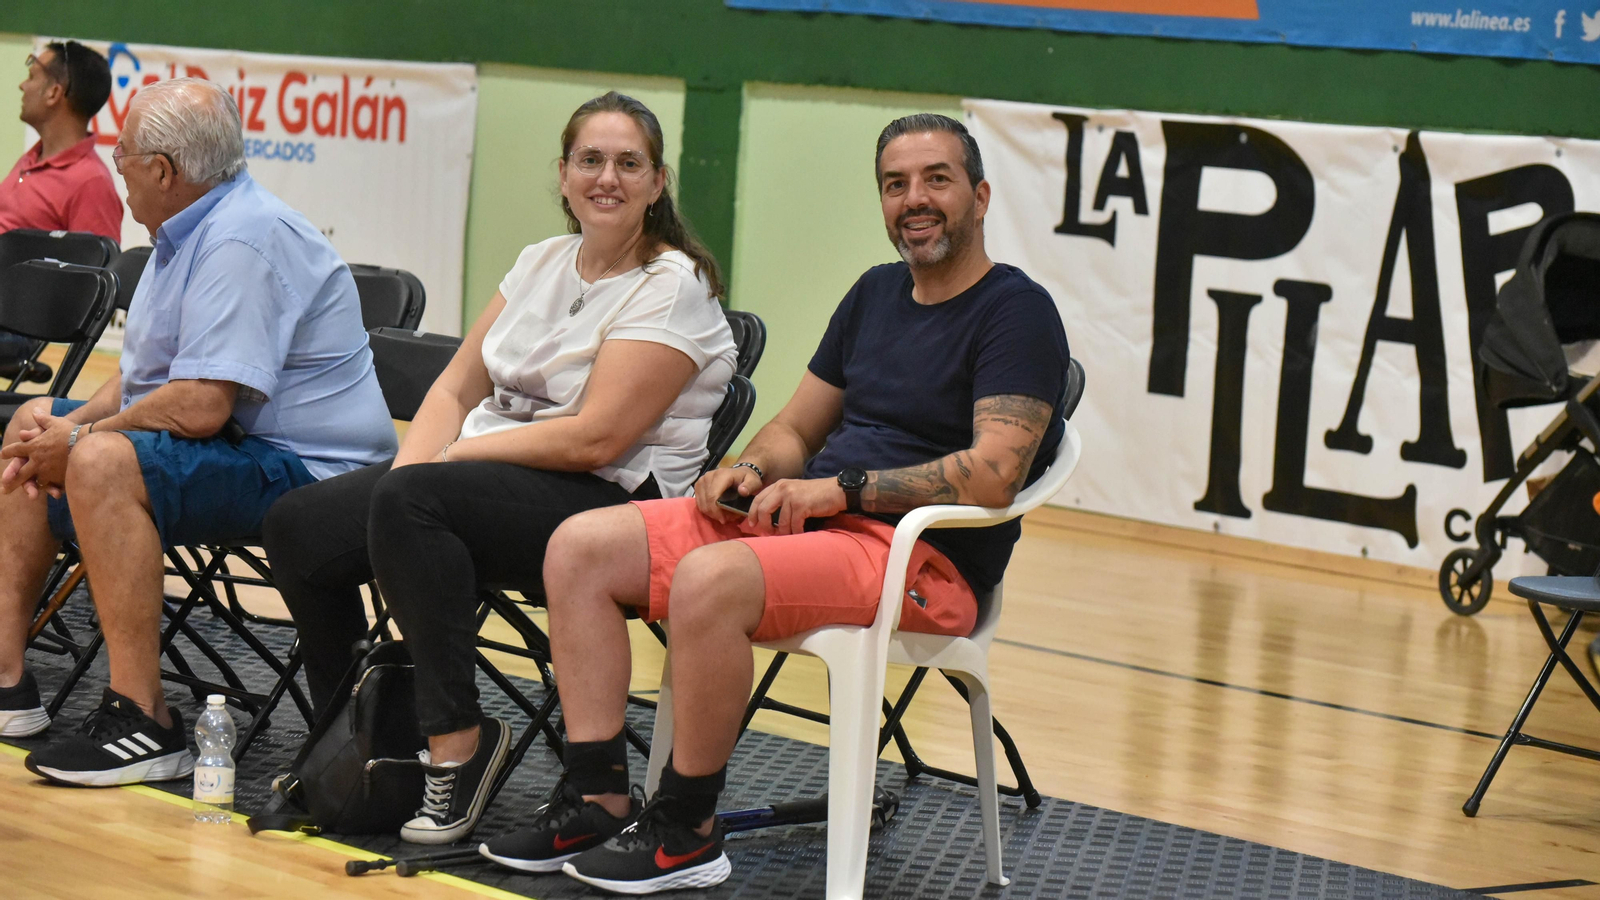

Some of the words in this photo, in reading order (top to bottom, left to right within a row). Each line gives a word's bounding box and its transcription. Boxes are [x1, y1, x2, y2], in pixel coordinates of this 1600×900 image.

[1411, 8, 1531, 32] www.lalinea.es
[277, 70, 407, 143] Galán
[245, 138, 316, 164] ERCADOS
[1052, 112, 1149, 249] LA
